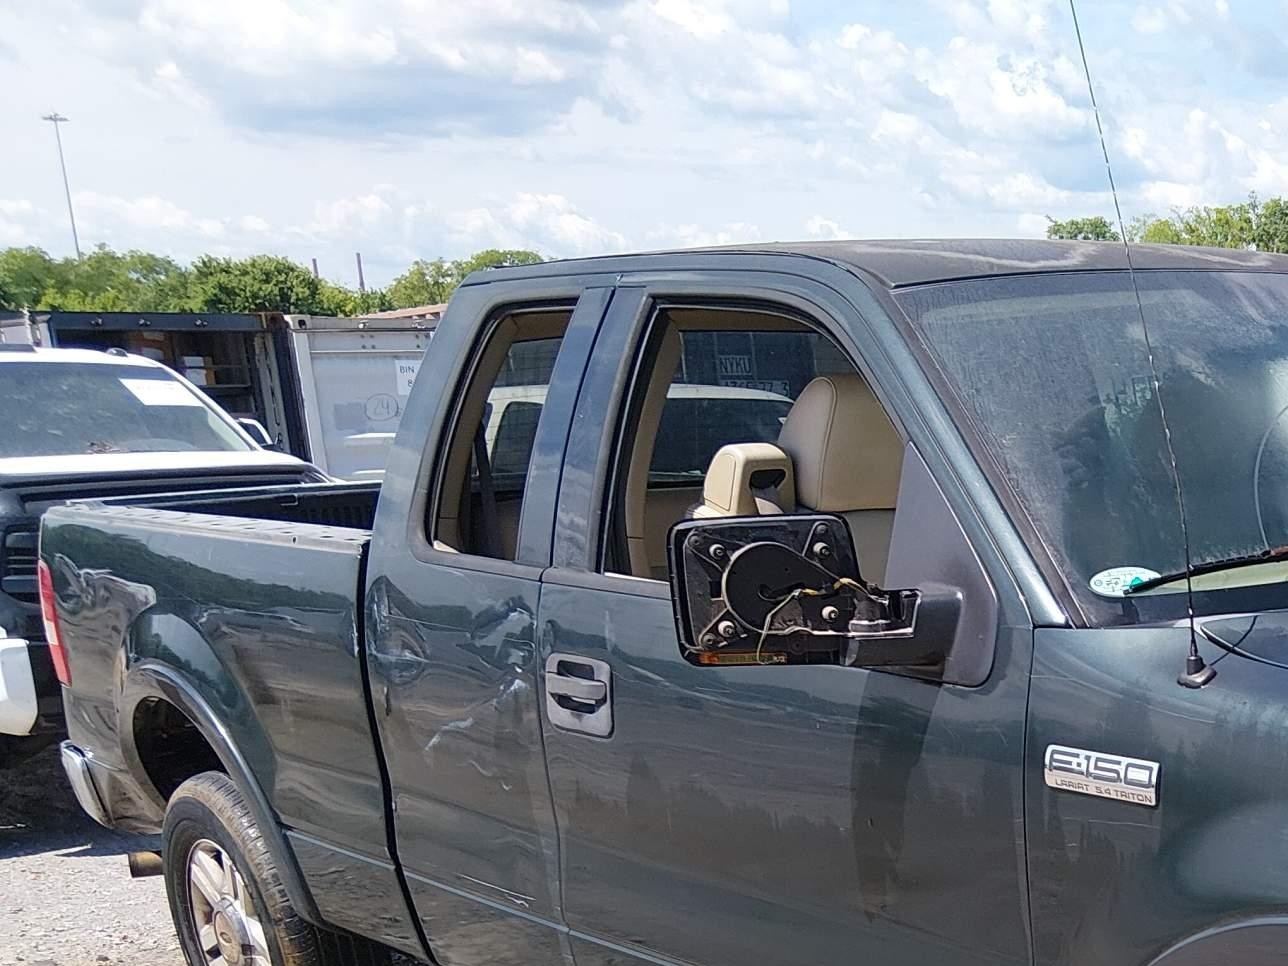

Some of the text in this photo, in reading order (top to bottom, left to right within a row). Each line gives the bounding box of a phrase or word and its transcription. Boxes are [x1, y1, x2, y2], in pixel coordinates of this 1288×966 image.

[399, 365, 415, 374] BIN
[1048, 749, 1154, 789] F-150
[1055, 778, 1089, 792] LARIAT
[1112, 789, 1153, 804] TRITON
